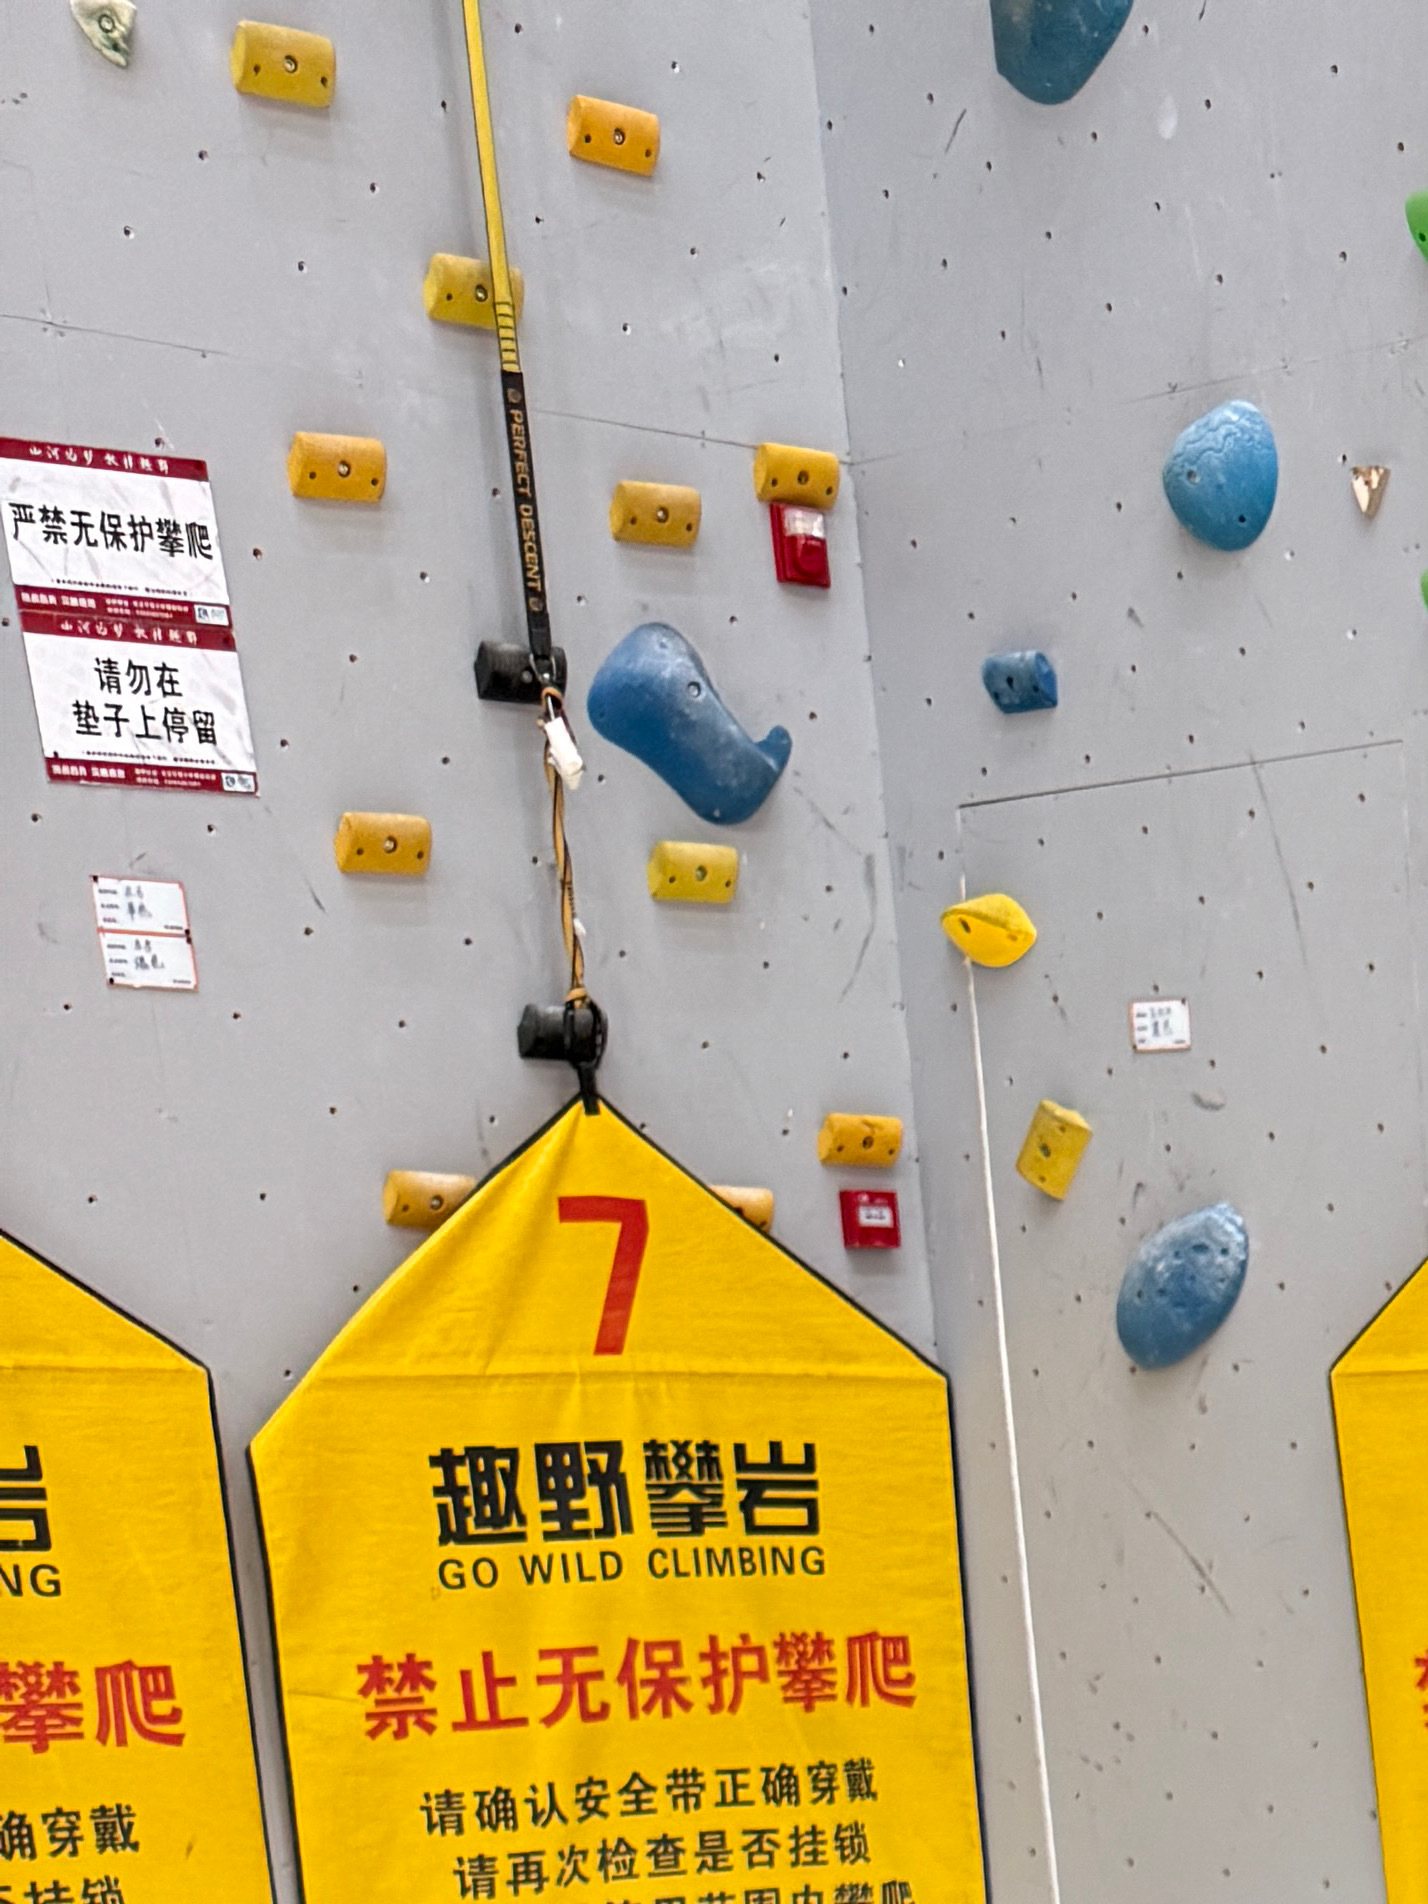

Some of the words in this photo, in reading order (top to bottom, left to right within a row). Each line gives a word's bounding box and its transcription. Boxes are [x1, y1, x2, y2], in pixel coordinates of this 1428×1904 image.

[509, 408, 532, 498] PERFECT
[8, 502, 214, 560] 严禁无保护攀爬
[518, 503, 542, 592] DESCENT
[94, 657, 183, 698] 请勿在
[72, 699, 218, 746] 垫子上停留
[558, 1196, 648, 1354] 7
[429, 1440, 821, 1552] 趣野攀岩
[439, 1558, 497, 1589] GO
[520, 1552, 621, 1584] WILD
[649, 1547, 824, 1578] CLIMBING
[0, 1661, 183, 1752] 攀爬
[358, 1632, 912, 1738] 禁止无保护攀爬
[419, 1756, 879, 1837] 请确认安全带正确穿戴
[452, 1819, 872, 1901] 请再次检查是否挂锁
